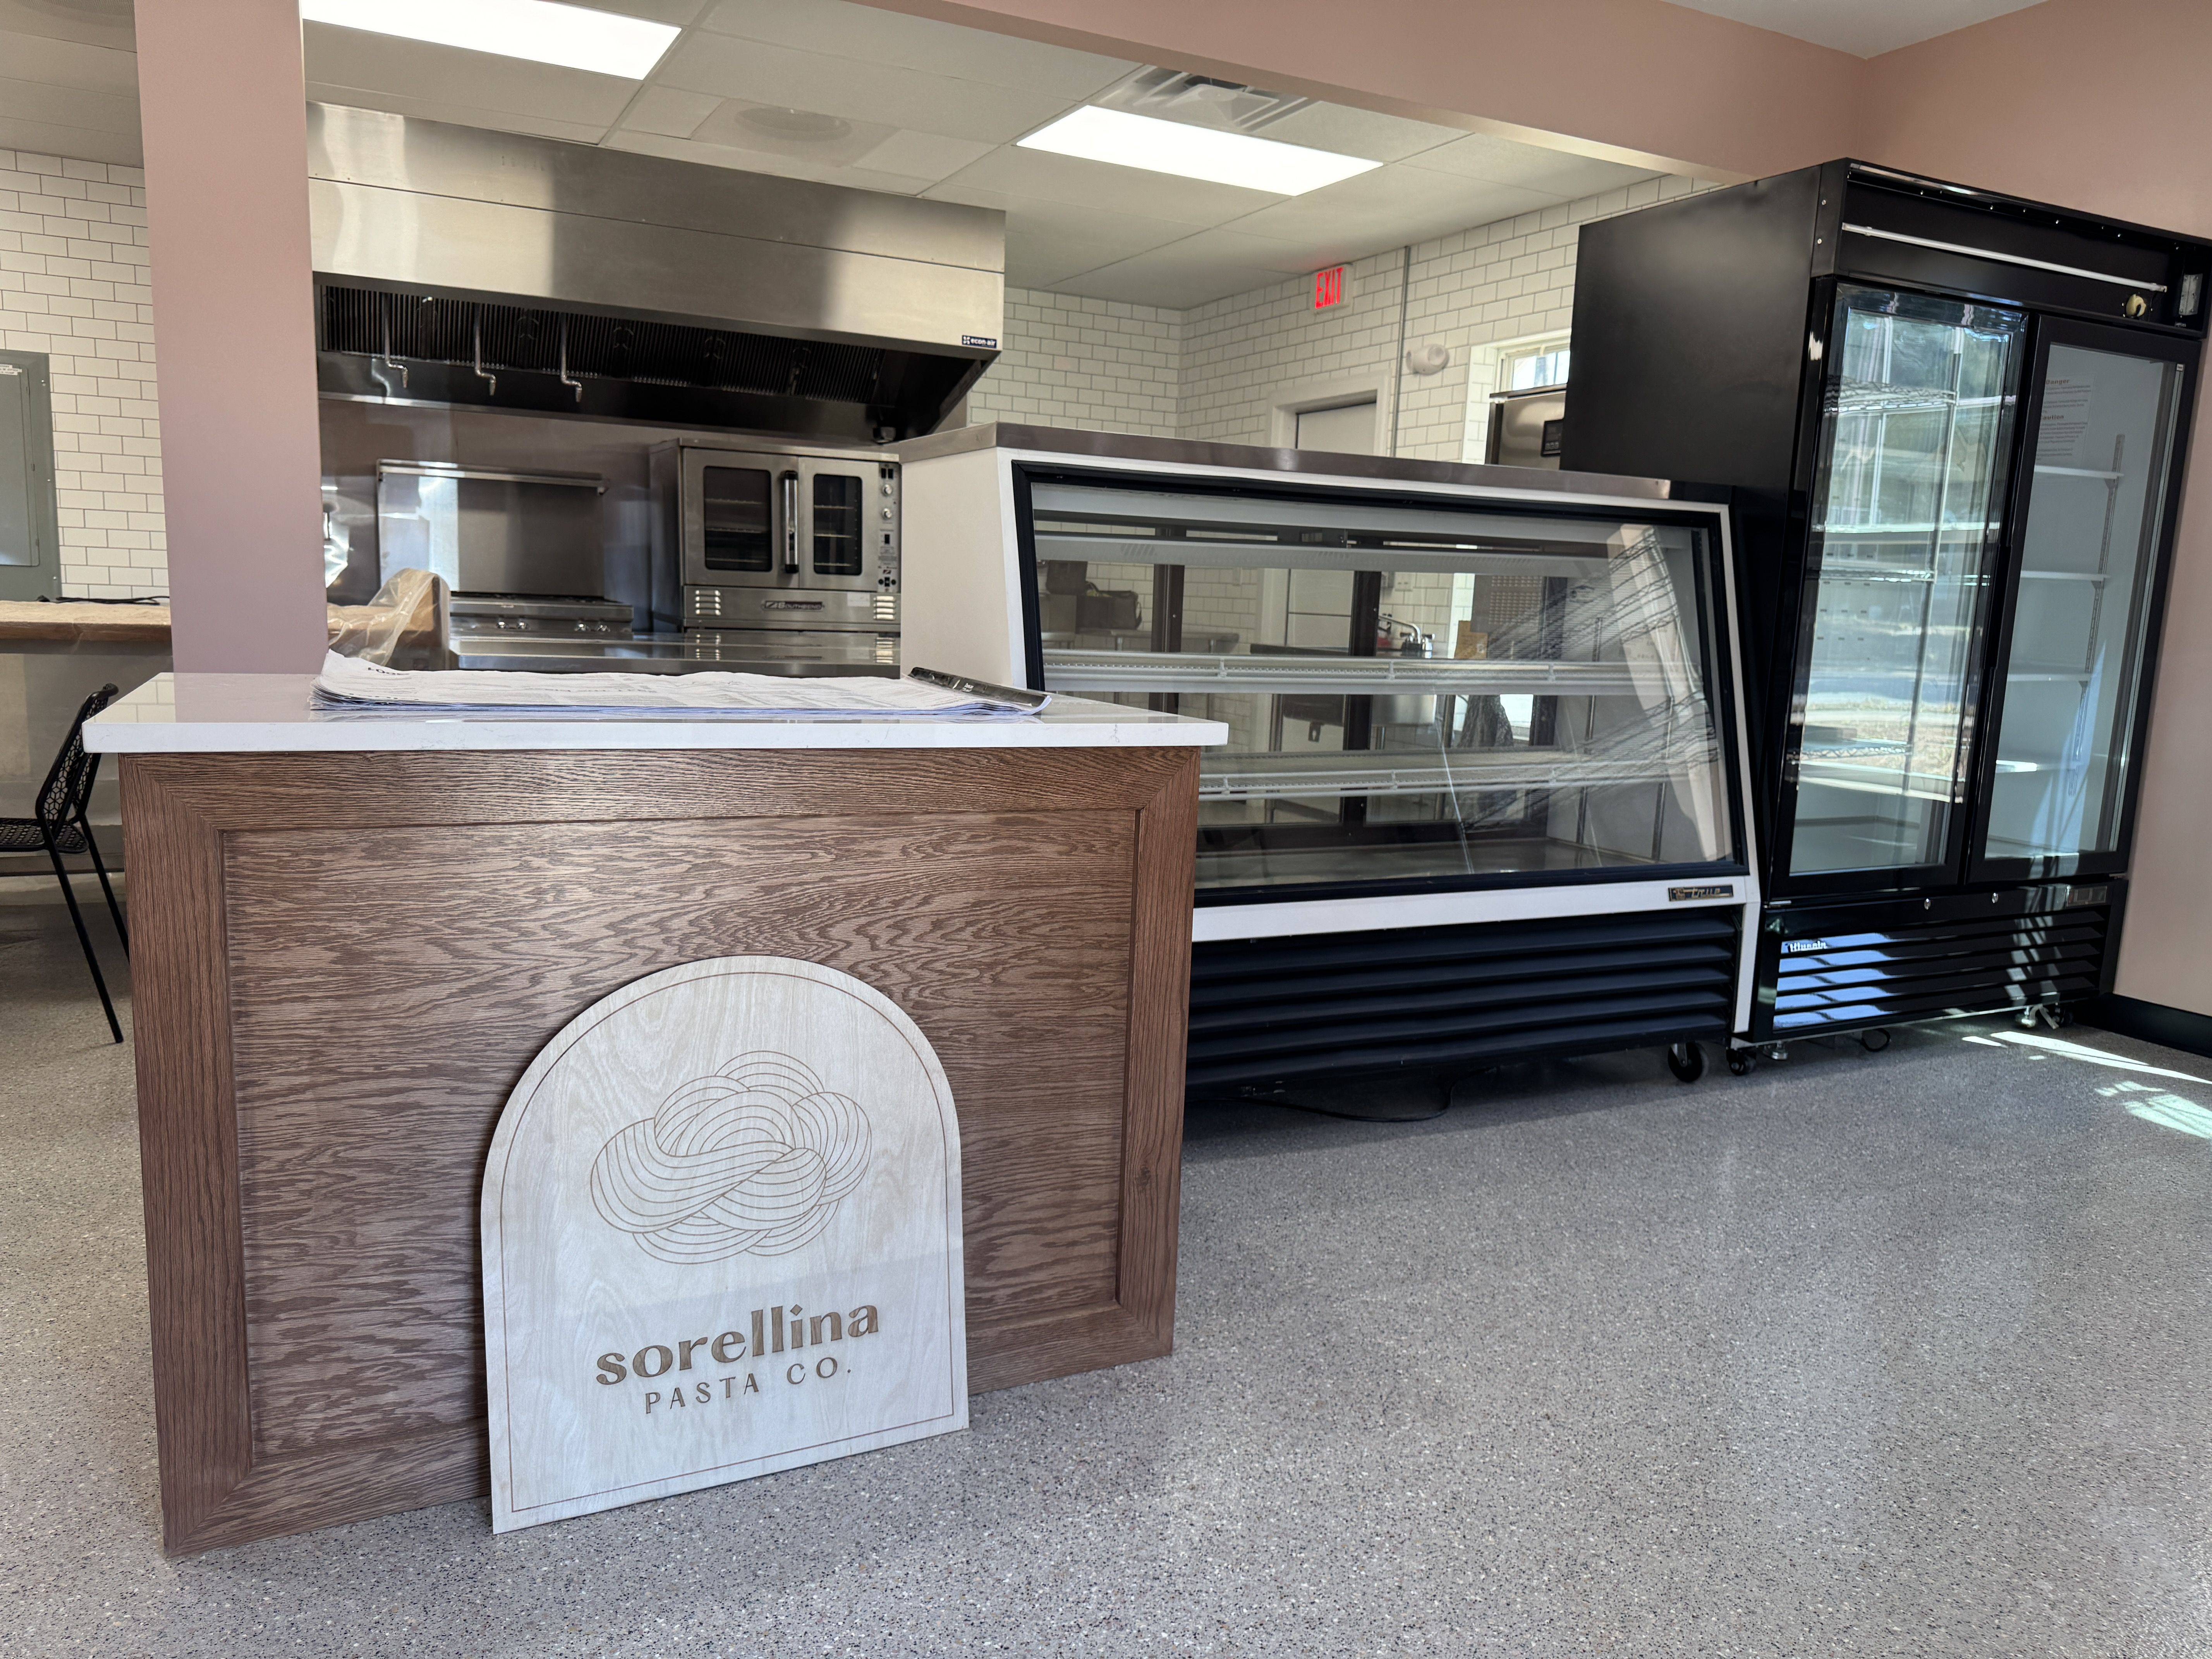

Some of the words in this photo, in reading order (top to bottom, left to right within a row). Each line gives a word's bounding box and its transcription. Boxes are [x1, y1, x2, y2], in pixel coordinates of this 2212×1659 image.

[1315, 267, 1343, 309] EXIT
[596, 1304, 879, 1385] sorellina
[645, 1373, 759, 1414] PASTA
[786, 1357, 852, 1385] CO.
